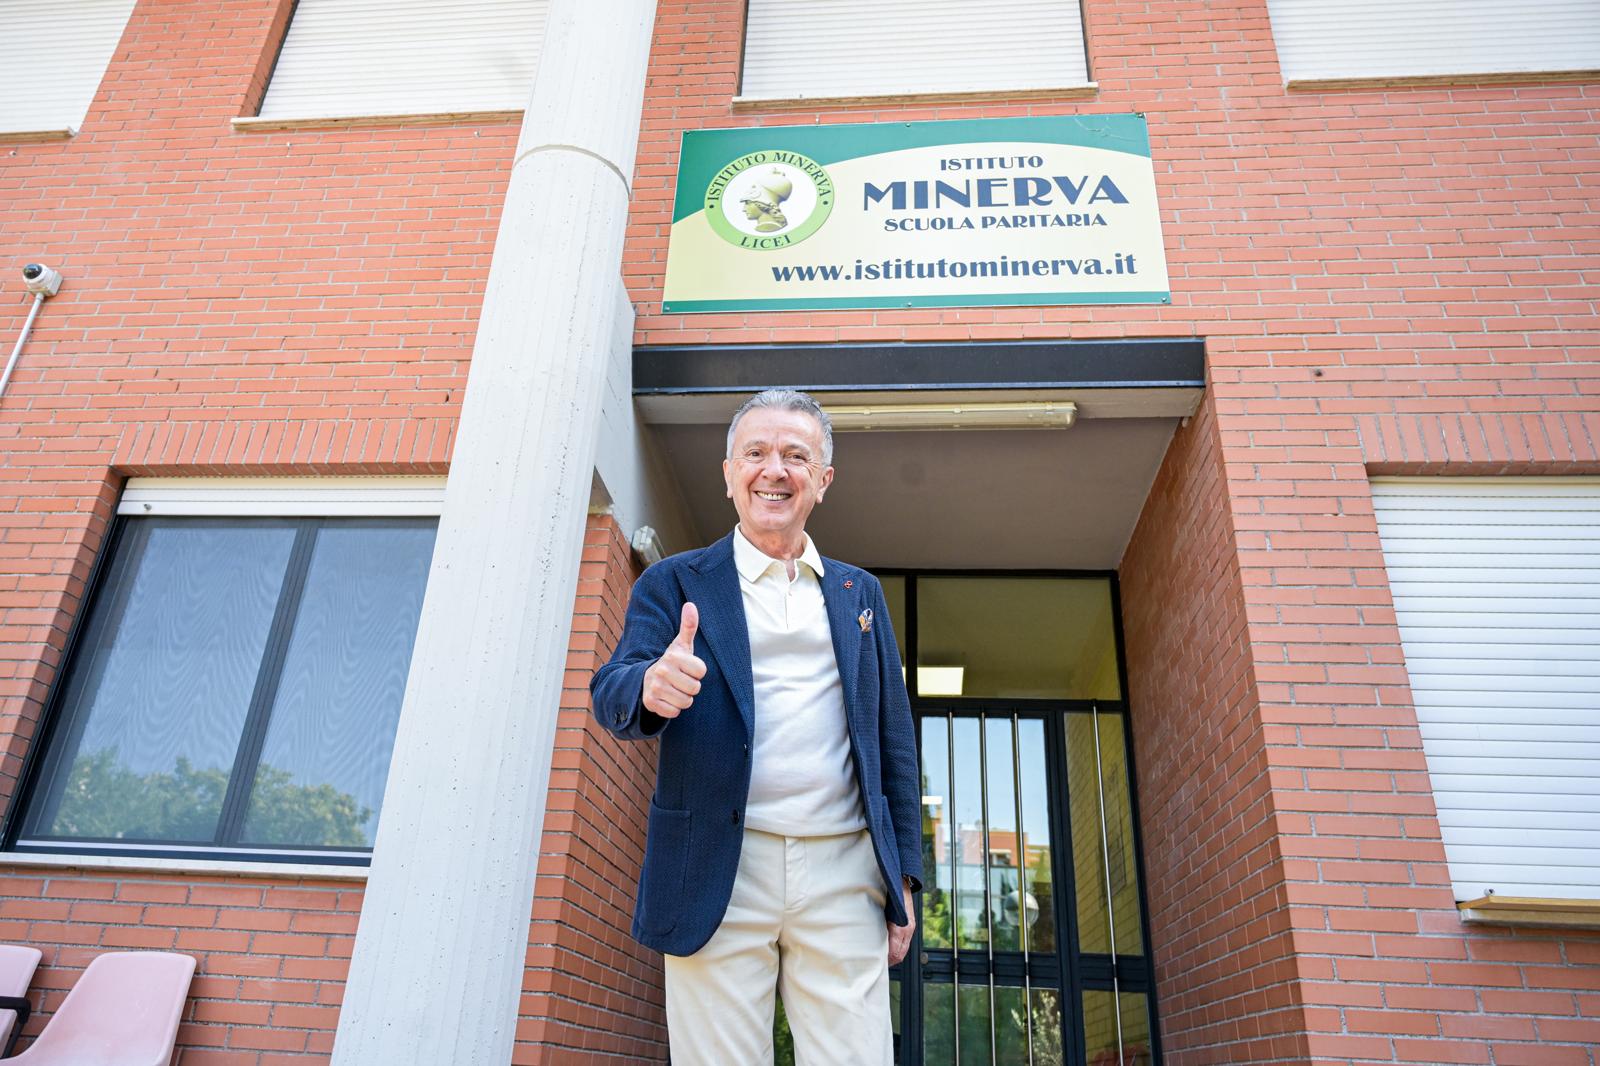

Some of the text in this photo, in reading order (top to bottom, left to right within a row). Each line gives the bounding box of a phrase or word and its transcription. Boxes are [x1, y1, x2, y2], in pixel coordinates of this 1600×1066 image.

[941, 156, 1043, 171] ISTITUTO
[707, 152, 831, 200] ISTITUTO MINERVA
[863, 175, 1129, 211] MINERVA
[884, 213, 1107, 232] SCUOLA PARITARIA
[740, 235, 791, 249] LICEI
[772, 253, 1138, 282] www.istitutominerva.it
